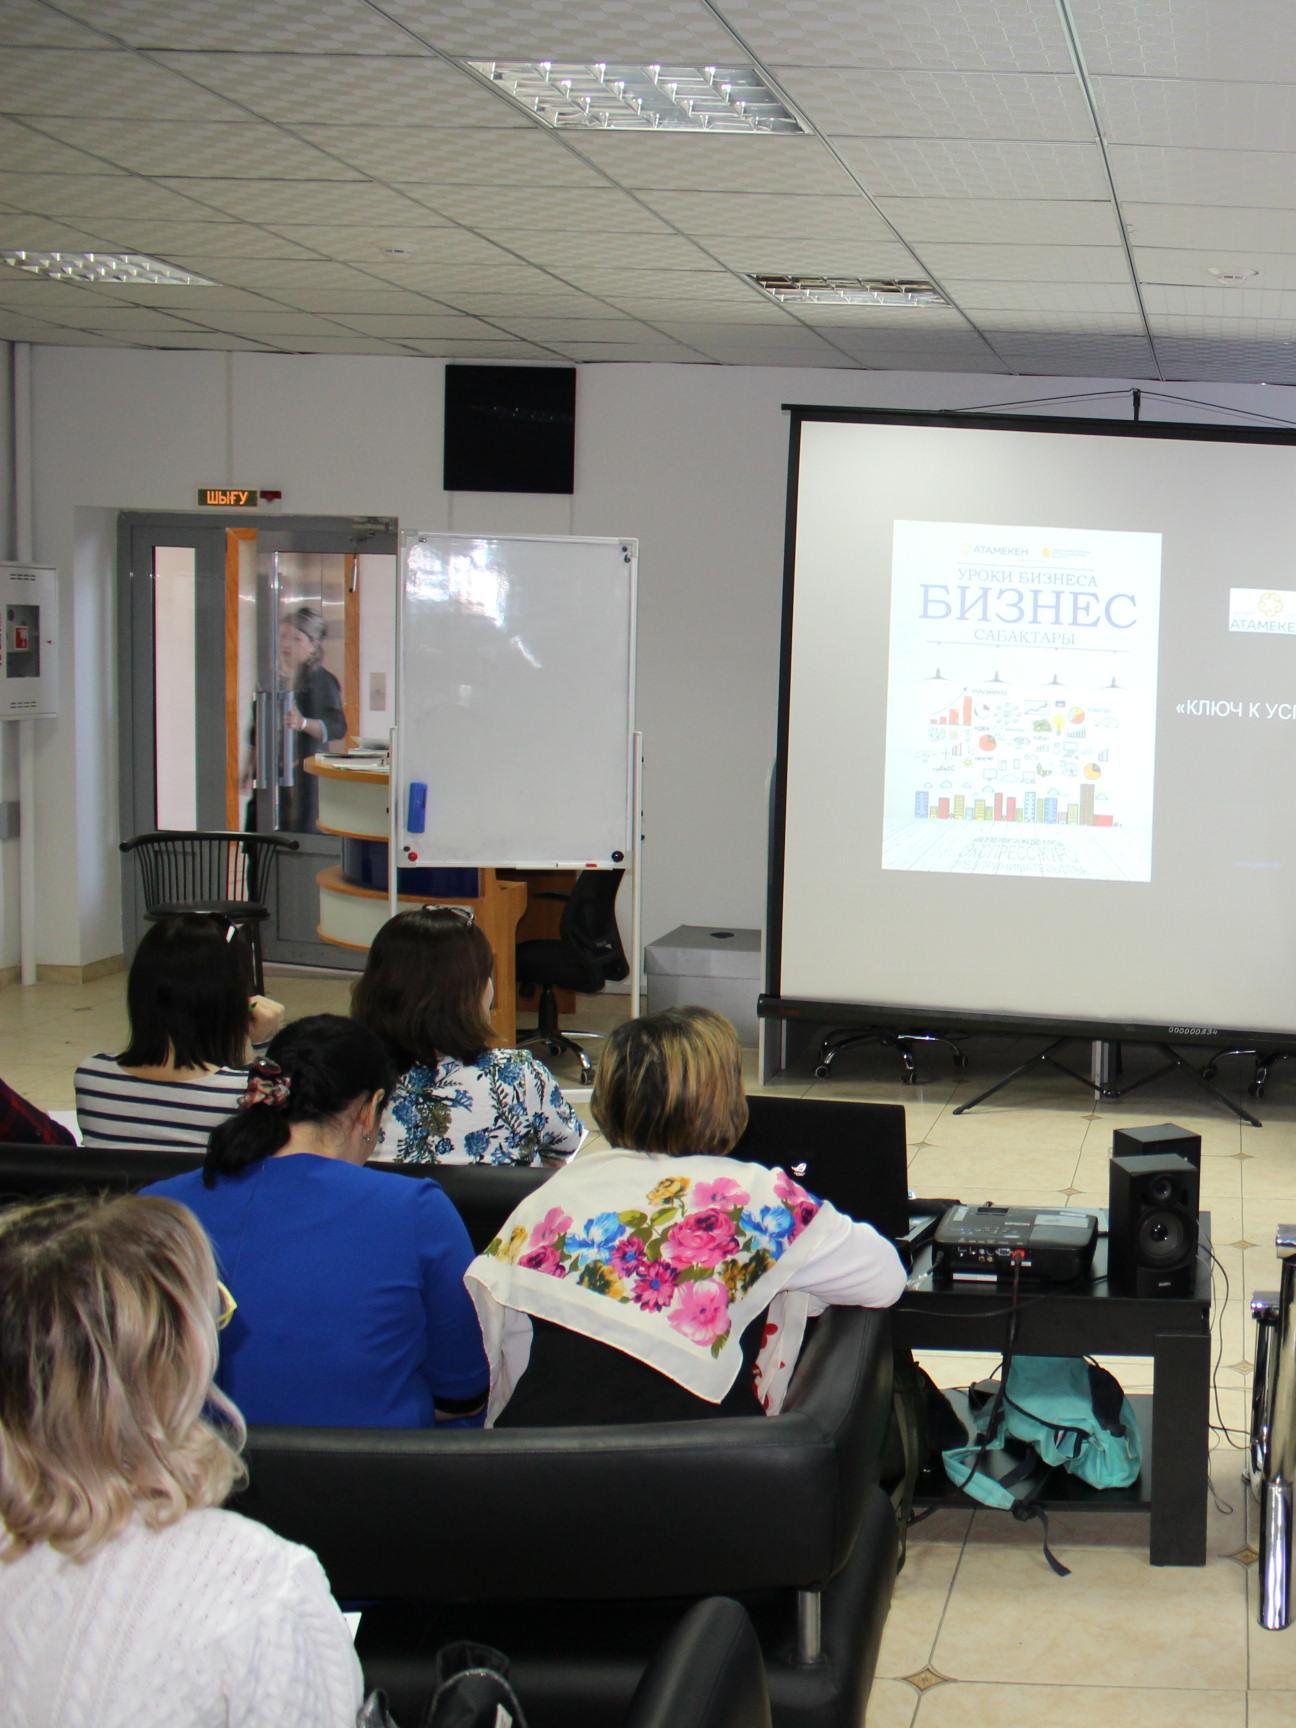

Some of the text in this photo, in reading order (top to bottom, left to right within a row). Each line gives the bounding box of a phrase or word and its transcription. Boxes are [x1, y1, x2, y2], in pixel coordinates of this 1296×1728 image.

[957, 568, 1098, 588] УРОКИ БИЗНЕСА
[918, 584, 1137, 629] БИЗНЕС
[1175, 700, 1243, 717] «КЛЮЧ
[1249, 702, 1260, 718] К
